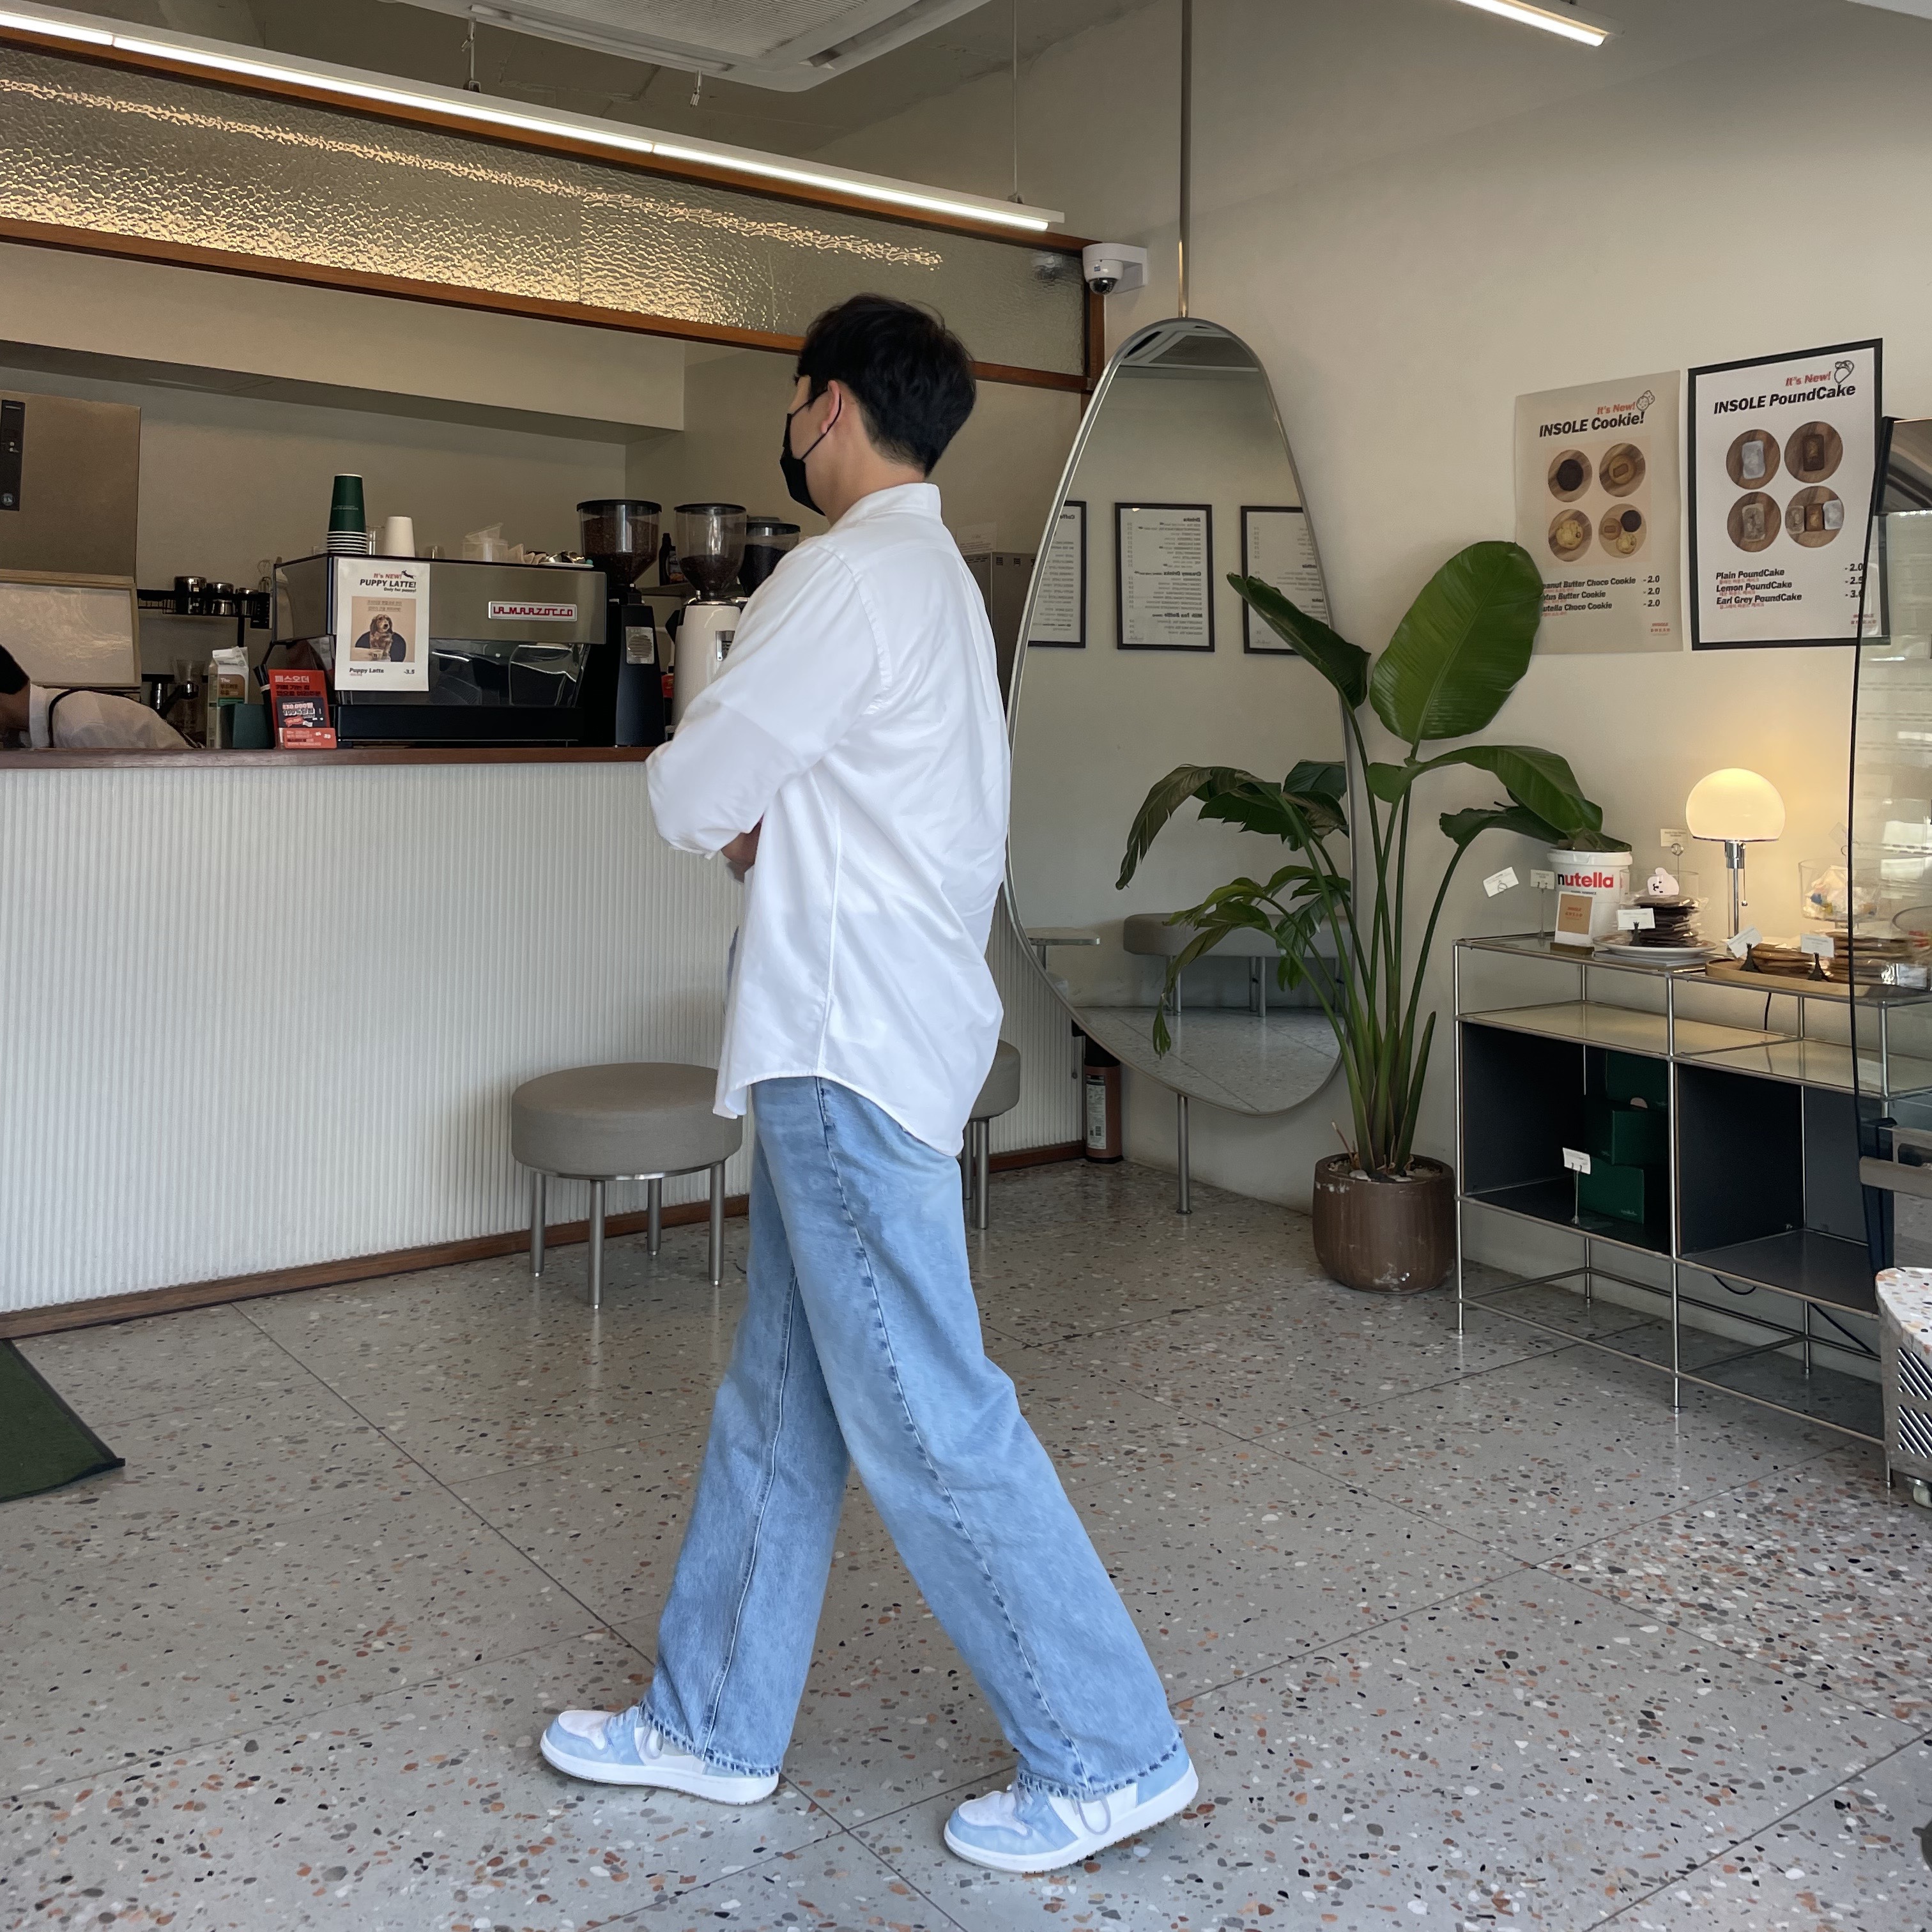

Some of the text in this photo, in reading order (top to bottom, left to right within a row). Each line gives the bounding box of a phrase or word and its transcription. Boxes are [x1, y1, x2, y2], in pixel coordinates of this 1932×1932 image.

[1786, 371, 1831, 387] It's New!
[1713, 385, 1856, 415] INSOLE PoundCake
[1597, 401, 1636, 415] It's New!
[1539, 411, 1645, 438] INSOLE Cookie!
[1738, 569, 1784, 579] PoundCake
[389, 580, 417, 588] LATTE!
[1543, 581, 1562, 589] eanut
[1716, 584, 1744, 592] Lemon
[1745, 581, 1792, 591] PoundCake
[1543, 592, 1556, 601] tus
[1717, 594, 1802, 606] Earl Grey PoundCake
[509, 607, 572, 617] MARZOCCO
[1565, 603, 1586, 611] Choco
[1558, 872, 1614, 888] nutella
